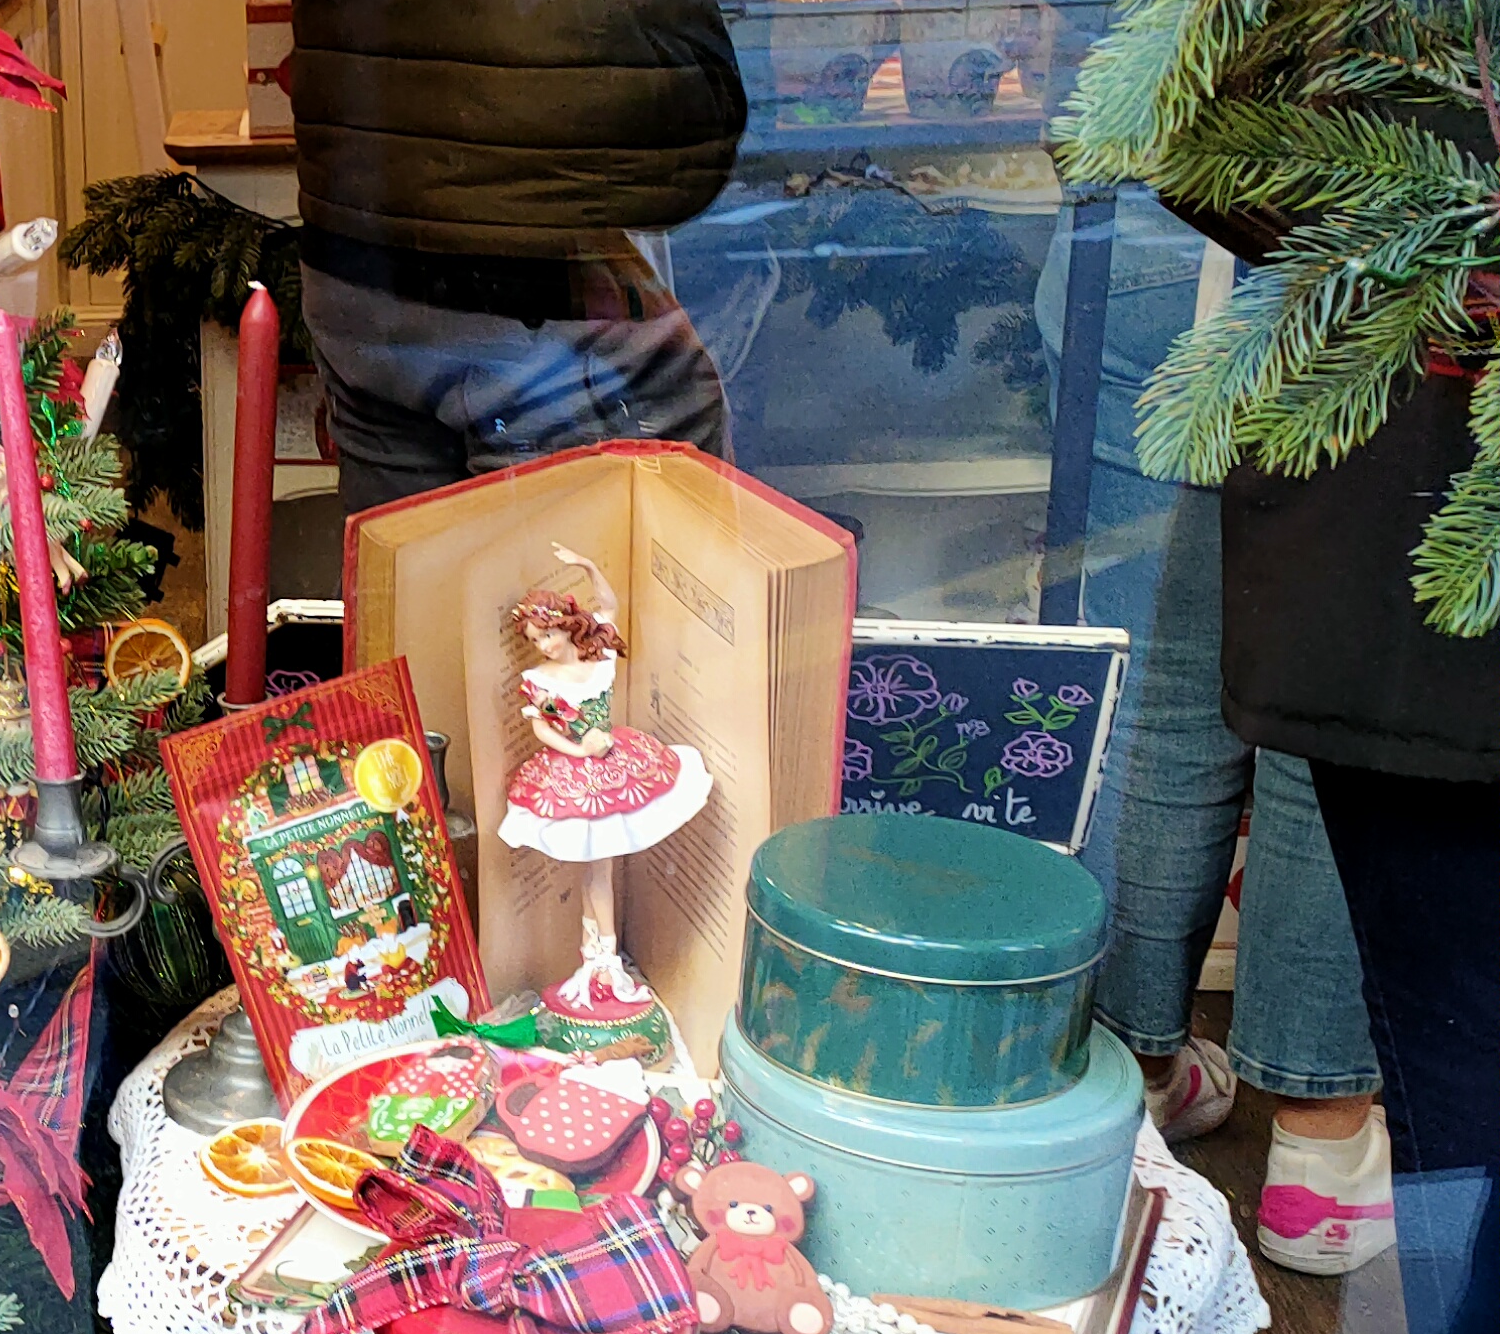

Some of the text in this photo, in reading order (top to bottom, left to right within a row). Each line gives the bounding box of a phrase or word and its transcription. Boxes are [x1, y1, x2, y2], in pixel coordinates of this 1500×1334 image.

[841, 785, 1038, 827] rrive vite
[262, 834, 279, 850] LA
[278, 821, 319, 844] PETITE
[320, 1034, 341, 1058] La
[340, 1021, 387, 1053] Petite
